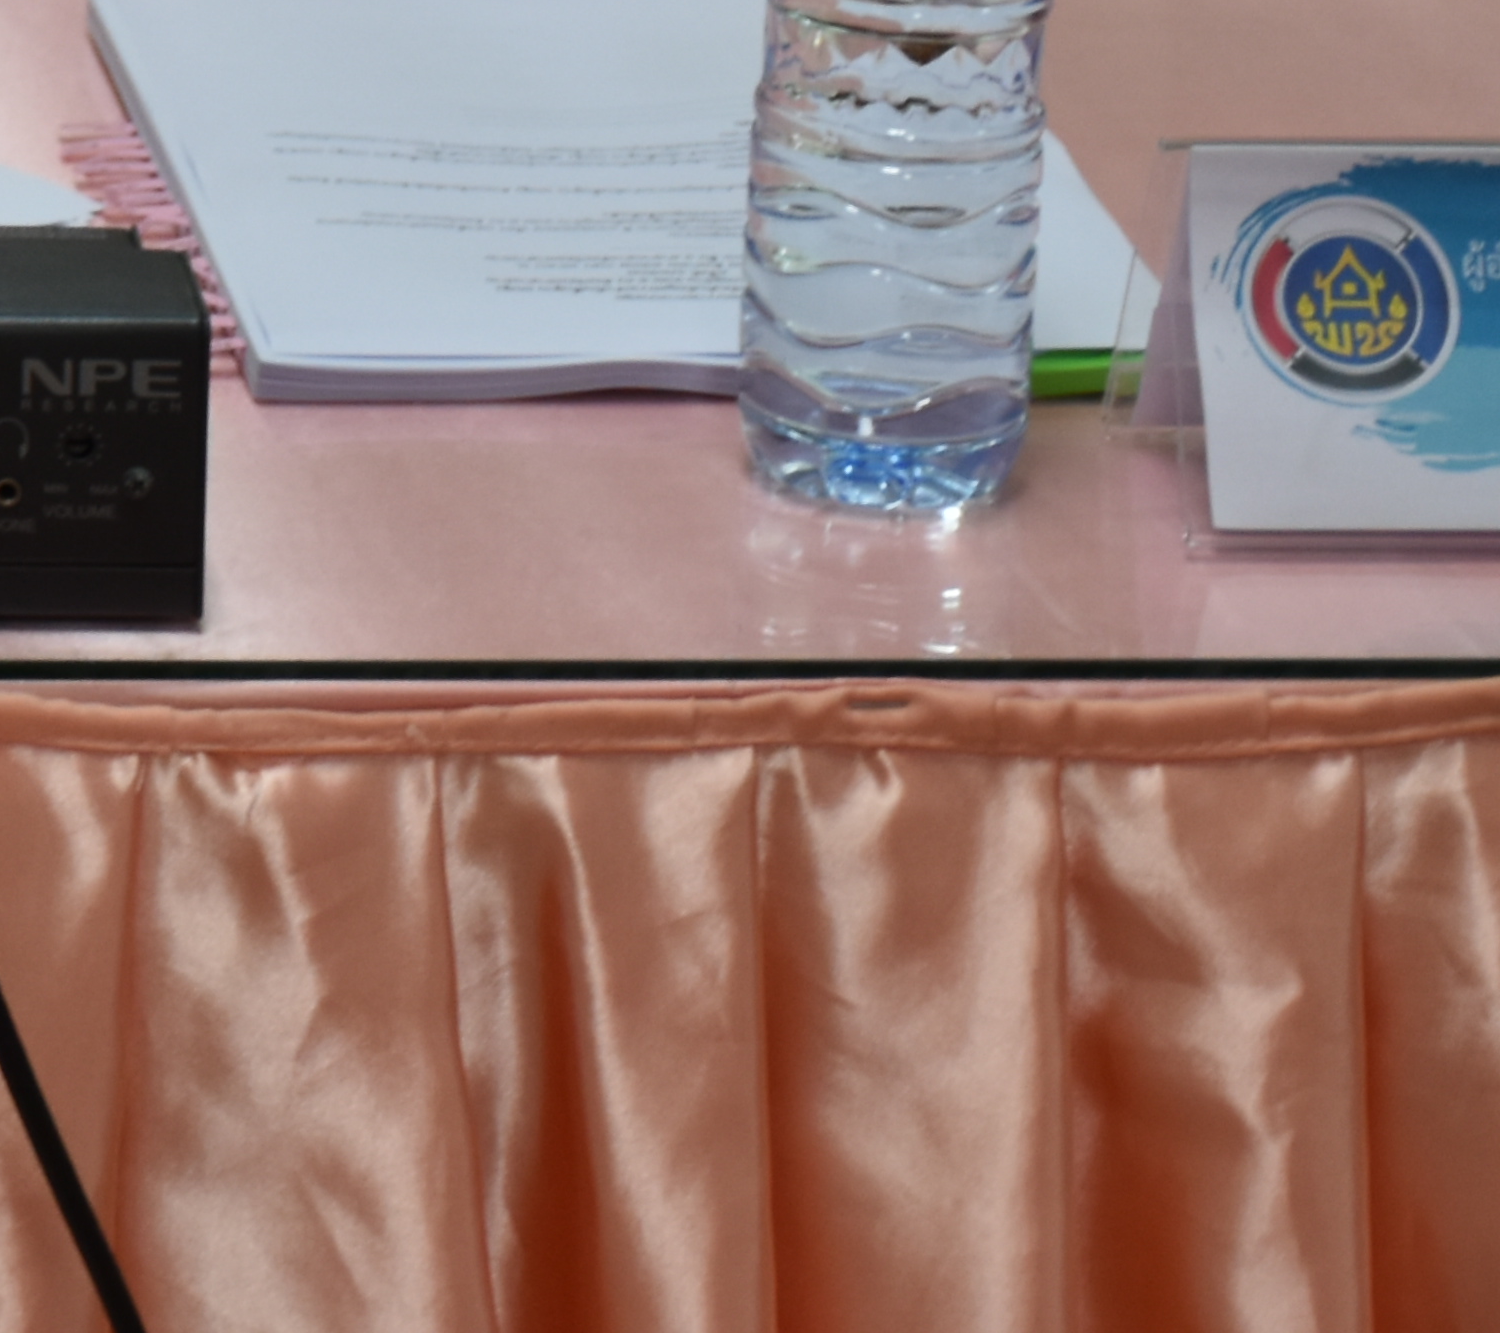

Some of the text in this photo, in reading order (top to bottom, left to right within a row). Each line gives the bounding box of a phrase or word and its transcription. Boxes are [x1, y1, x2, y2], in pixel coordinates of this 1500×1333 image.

[21, 358, 184, 399] NPE
[20, 399, 184, 413] RESEARCH
[42, 502, 118, 520] VOLUME
